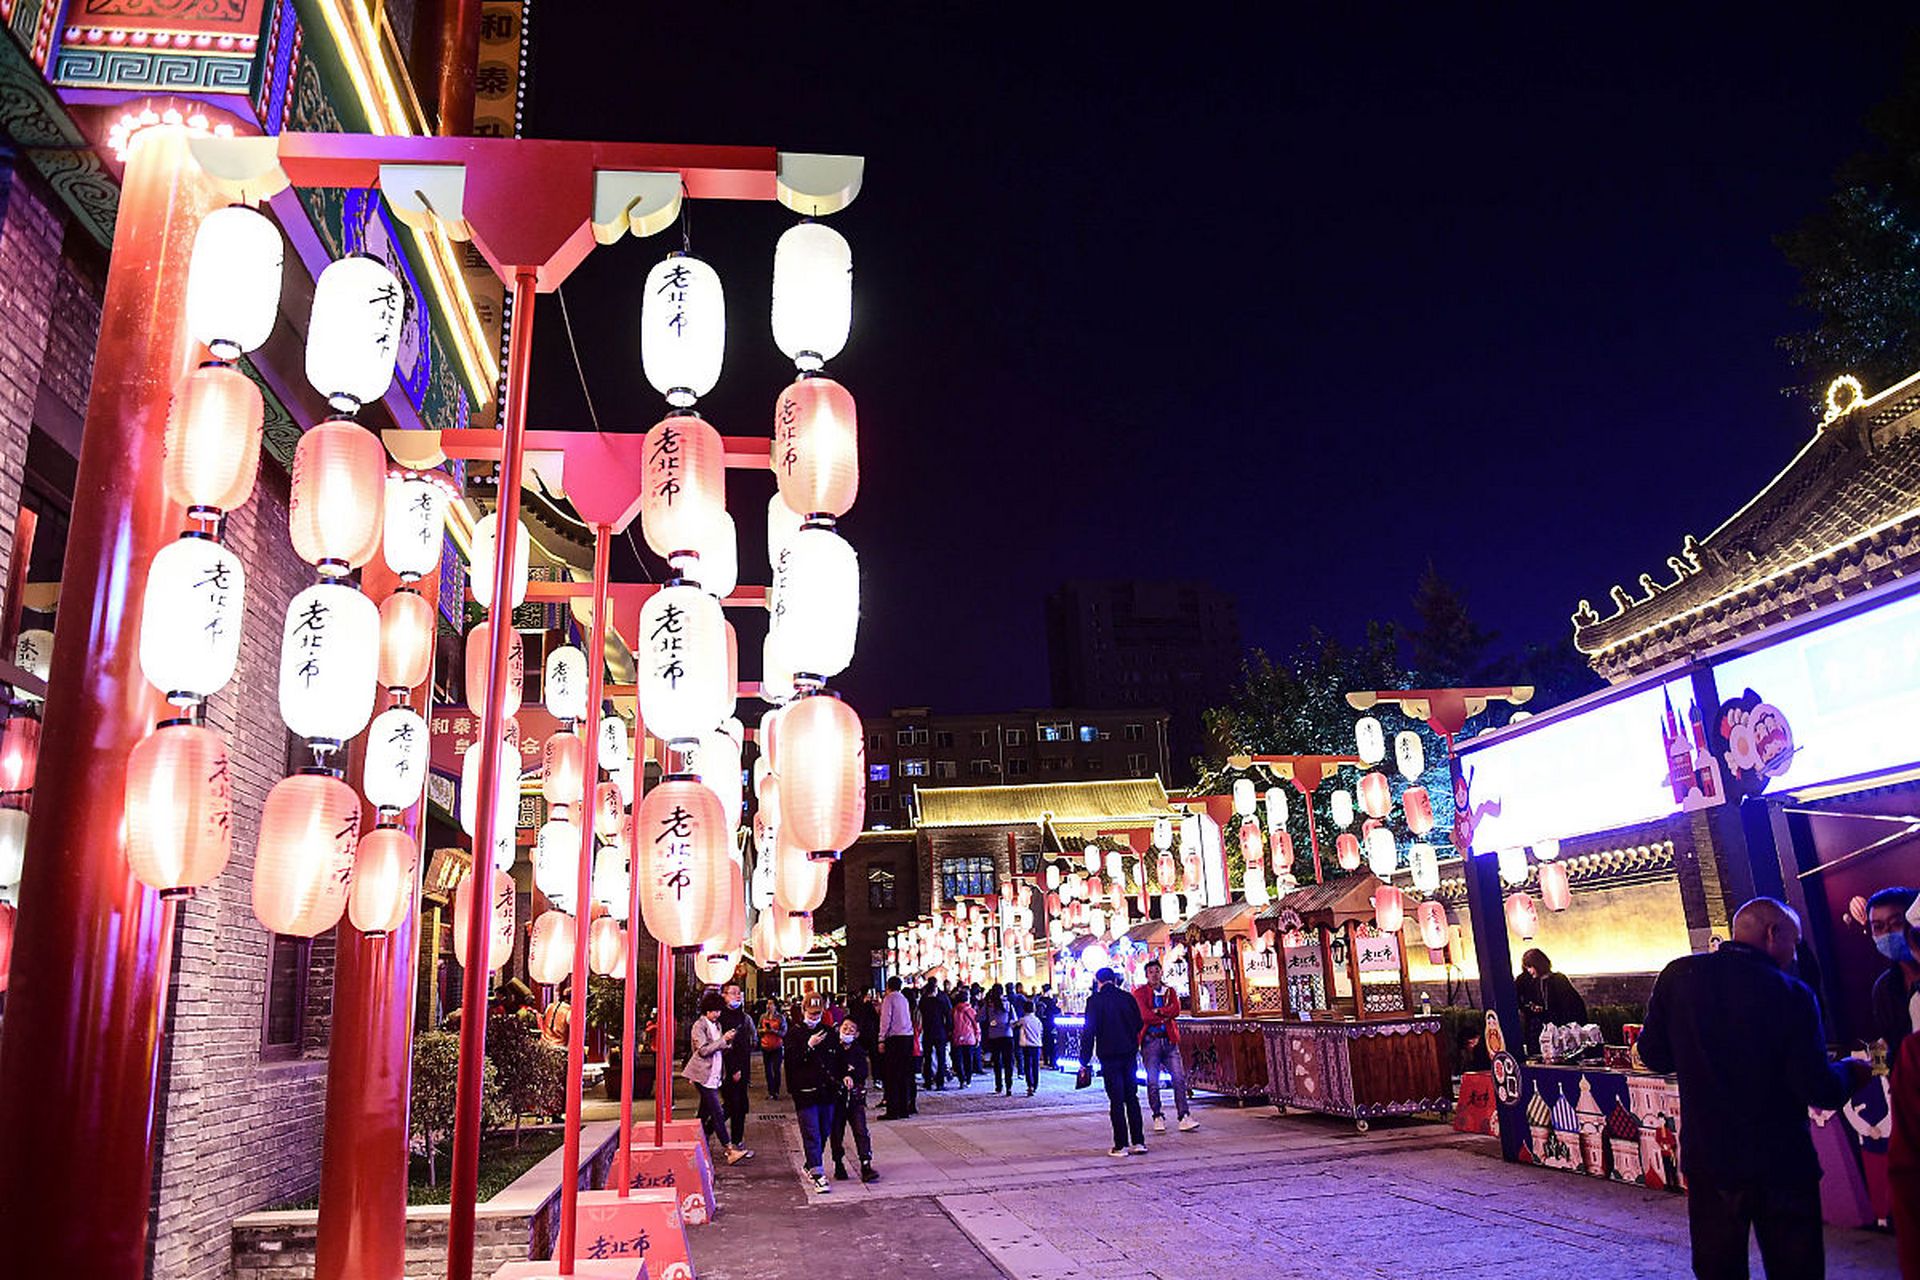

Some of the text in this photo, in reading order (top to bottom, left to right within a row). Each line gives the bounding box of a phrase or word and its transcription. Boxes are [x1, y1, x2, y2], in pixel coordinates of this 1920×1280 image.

[367, 281, 398, 359] 老北市
[656, 264, 692, 338] 老北市
[648, 426, 682, 508] 老北市
[407, 492, 433, 546] 老北市
[191, 558, 230, 646] 老北市
[291, 599, 330, 690] 老北市
[649, 602, 686, 691] 老北市
[387, 721, 415, 779] 老北市
[652, 804, 695, 902] 老北市
[1360, 944, 1393, 964] 老北市
[586, 1228, 651, 1259] 老北市
